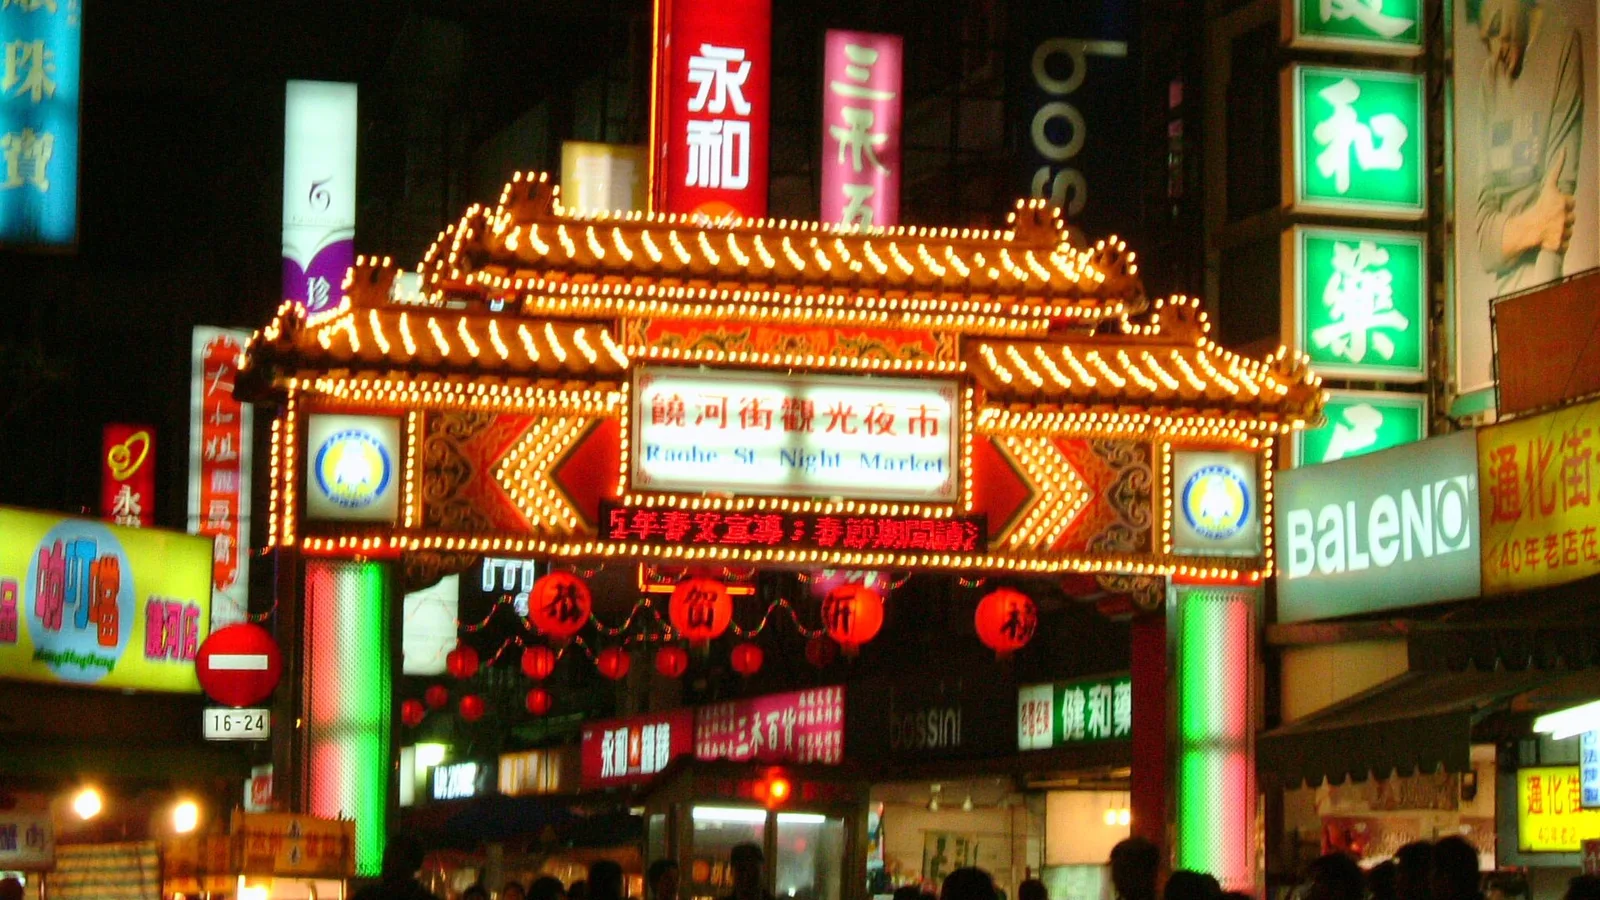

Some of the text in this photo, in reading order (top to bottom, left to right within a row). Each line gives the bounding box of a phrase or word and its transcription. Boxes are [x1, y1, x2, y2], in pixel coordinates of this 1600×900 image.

[0, 0, 57, 192] 珠寶
[686, 43, 752, 190] 永和
[651, 393, 942, 439] 饒河街觀光夜市
[646, 445, 718, 462] Raohe
[780, 447, 841, 474] Night
[860, 452, 945, 473] Market
[1489, 427, 1600, 526] 通化街
[213, 714, 264, 732] 16-24
